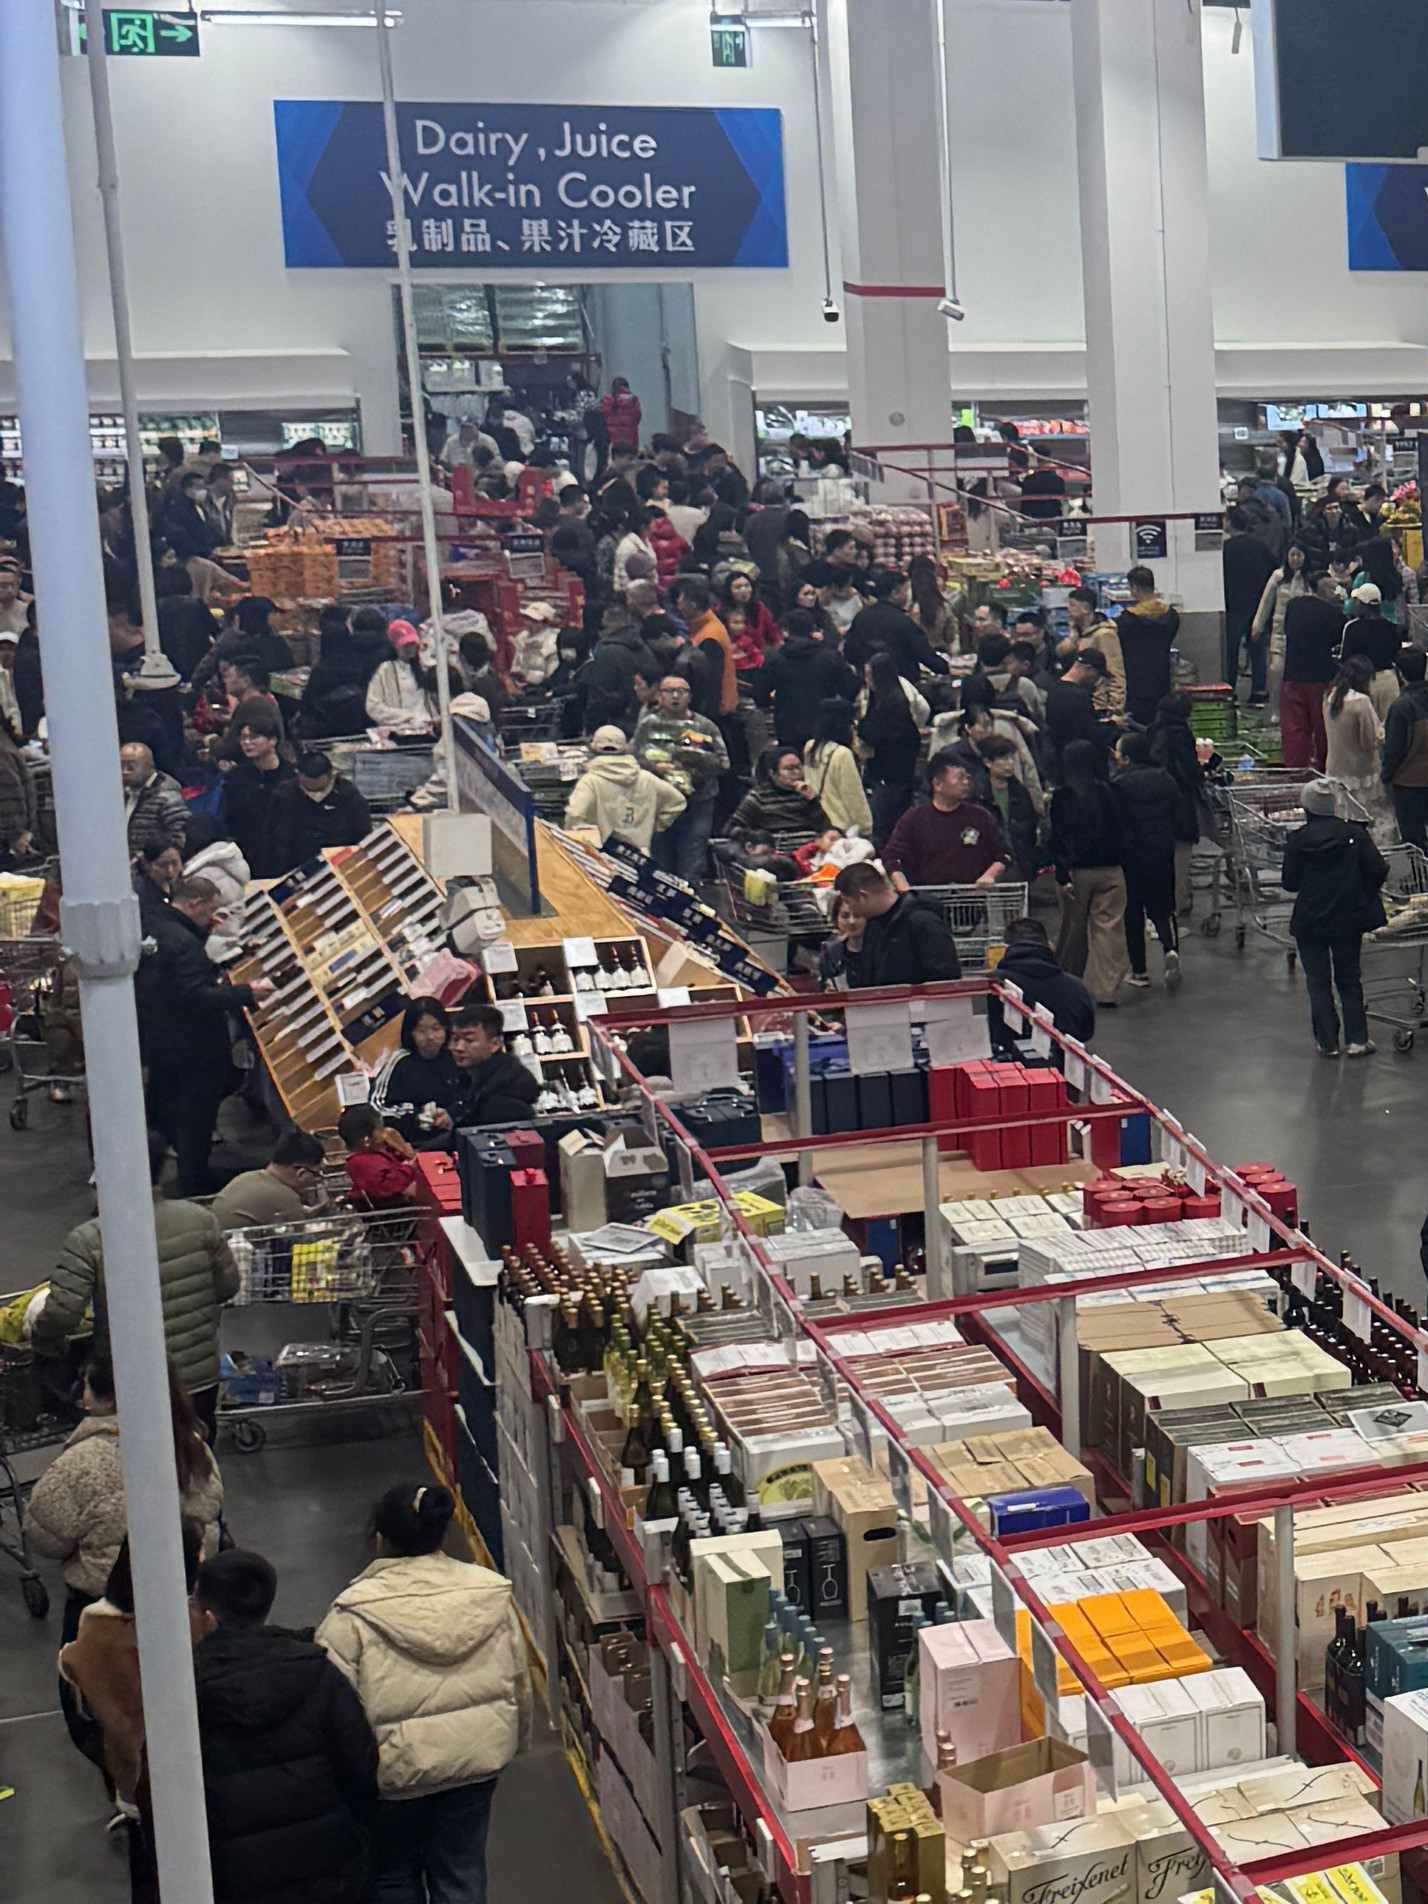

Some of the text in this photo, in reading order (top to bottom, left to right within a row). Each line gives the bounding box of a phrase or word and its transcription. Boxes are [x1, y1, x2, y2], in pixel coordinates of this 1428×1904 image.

[554, 120, 658, 159] Juice
[379, 170, 696, 209] Walk-in Cooler
